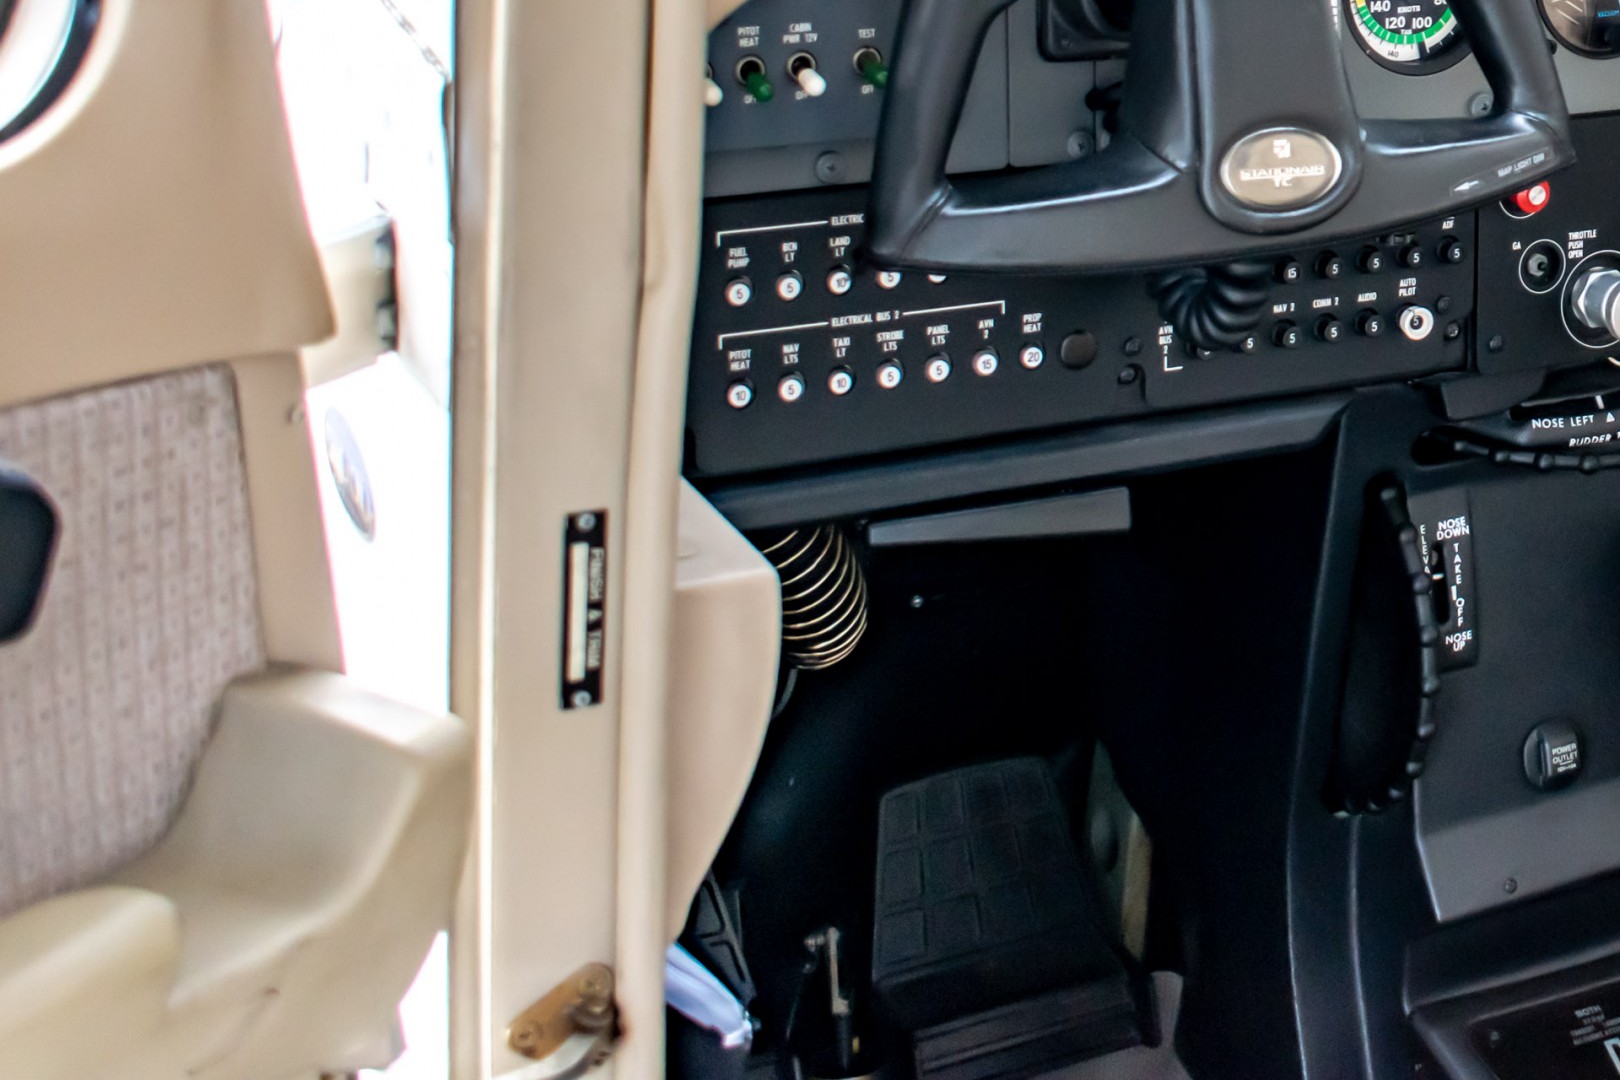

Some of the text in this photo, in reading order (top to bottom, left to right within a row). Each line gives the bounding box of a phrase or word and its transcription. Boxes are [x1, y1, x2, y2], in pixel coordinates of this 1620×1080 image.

[1370, 0, 1391, 13] 140
[1397, 5, 1421, 14] KNOTS
[789, 23, 812, 33] CABIN
[1385, 16, 1433, 29] 120 100
[737, 26, 760, 37] PITOT
[858, 28, 875, 39] TEST
[739, 37, 759, 47] HEAT
[1498, 153, 1545, 178] MAP LIGHT DIM
[1442, 220, 1454, 230] ADF
[1568, 229, 1597, 240] THROTTLE
[830, 235, 850, 247] LAND
[1512, 241, 1521, 251] GA
[1568, 239, 1583, 250] PUSH
[729, 248, 748, 258] FUEL
[1568, 248, 1583, 260] OPEN
[728, 257, 749, 268] PUMP
[1399, 277, 1417, 288] AUTO
[1358, 291, 1377, 303] AUDIO
[1399, 286, 1416, 297] PILOT
[1273, 302, 1288, 313] NAV
[1313, 297, 1332, 308] COMM
[832, 310, 890, 326] ELECTRICAL BUS
[1023, 313, 1042, 324] PROP
[927, 324, 950, 335] PANEL
[979, 319, 994, 330] AVN
[1023, 322, 1042, 333] HEAT
[877, 330, 904, 342] STROBE
[833, 337, 850, 348] TAXI
[783, 344, 799, 354] NAV
[729, 349, 751, 361] PITOT
[1028, 351, 1040, 362] 20
[730, 359, 750, 370] HEAT
[1532, 416, 1565, 429] NOSE
[1570, 414, 1594, 427] LEFT
[1569, 432, 1612, 447] RUDDER
[1438, 516, 1466, 531] NOSE
[1436, 525, 1470, 540] DOWN
[1453, 542, 1465, 628] TAKE OFF
[1445, 630, 1473, 645] NOSE
[1453, 640, 1466, 652] UP
[1552, 742, 1577, 755] POWER
[1552, 751, 1578, 765] OUTLET
[1574, 1005, 1602, 1018] BOTH
